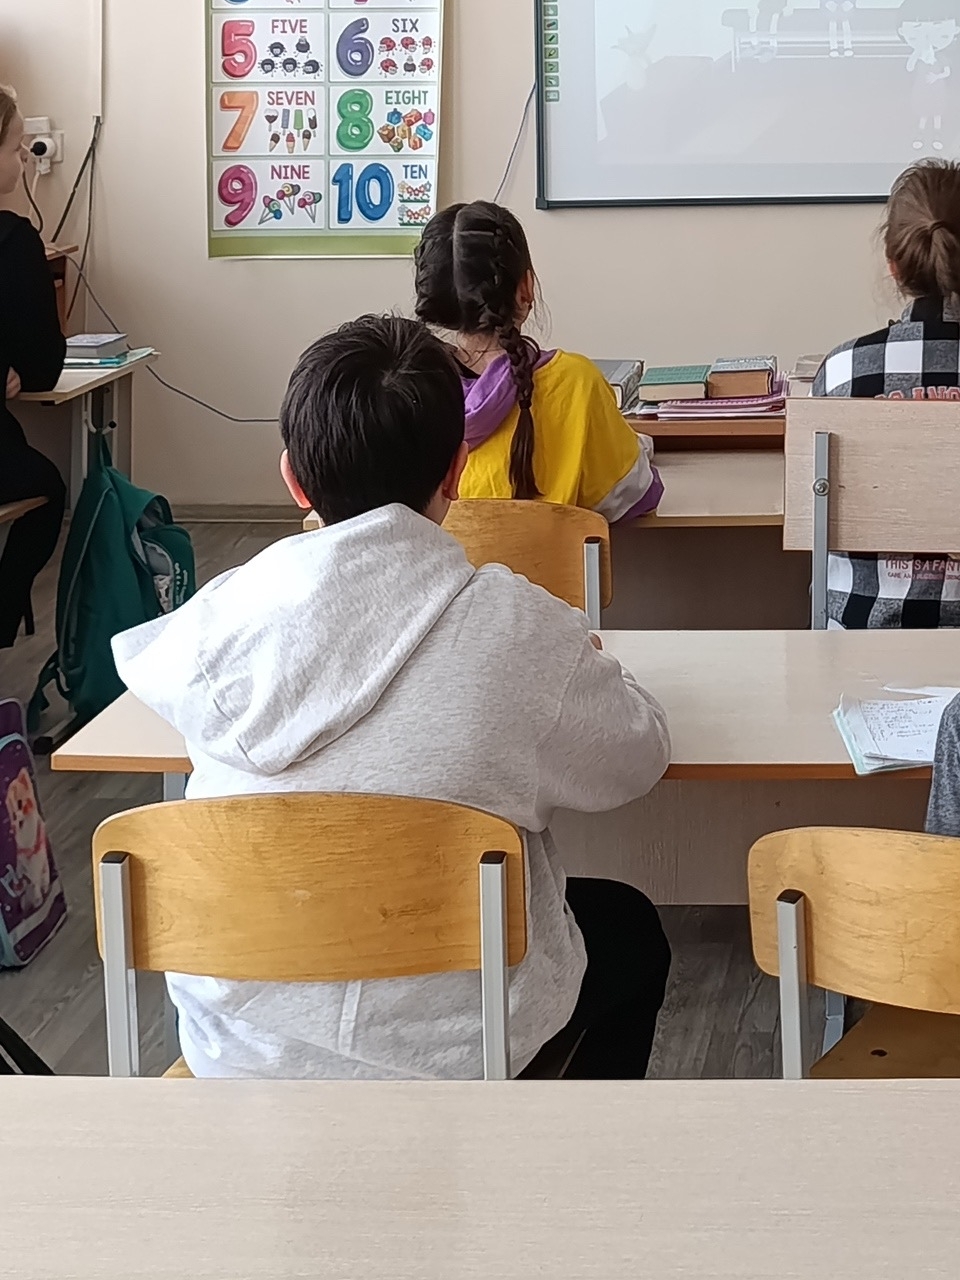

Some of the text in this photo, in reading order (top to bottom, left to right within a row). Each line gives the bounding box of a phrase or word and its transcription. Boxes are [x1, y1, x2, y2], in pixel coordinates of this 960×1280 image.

[271, 19, 308, 35] FIVE
[392, 18, 418, 34] SIX
[221, 20, 257, 78] 5
[336, 18, 374, 78] 6
[267, 90, 314, 106] SEVEN
[385, 90, 428, 106] EIGHT
[220, 91, 259, 152] 7
[336, 89, 374, 152] 8
[270, 165, 310, 180] NINE
[403, 164, 428, 180] TEN
[218, 164, 258, 227] 9
[332, 163, 395, 224] 10
[885, 559, 909, 570] THIS
